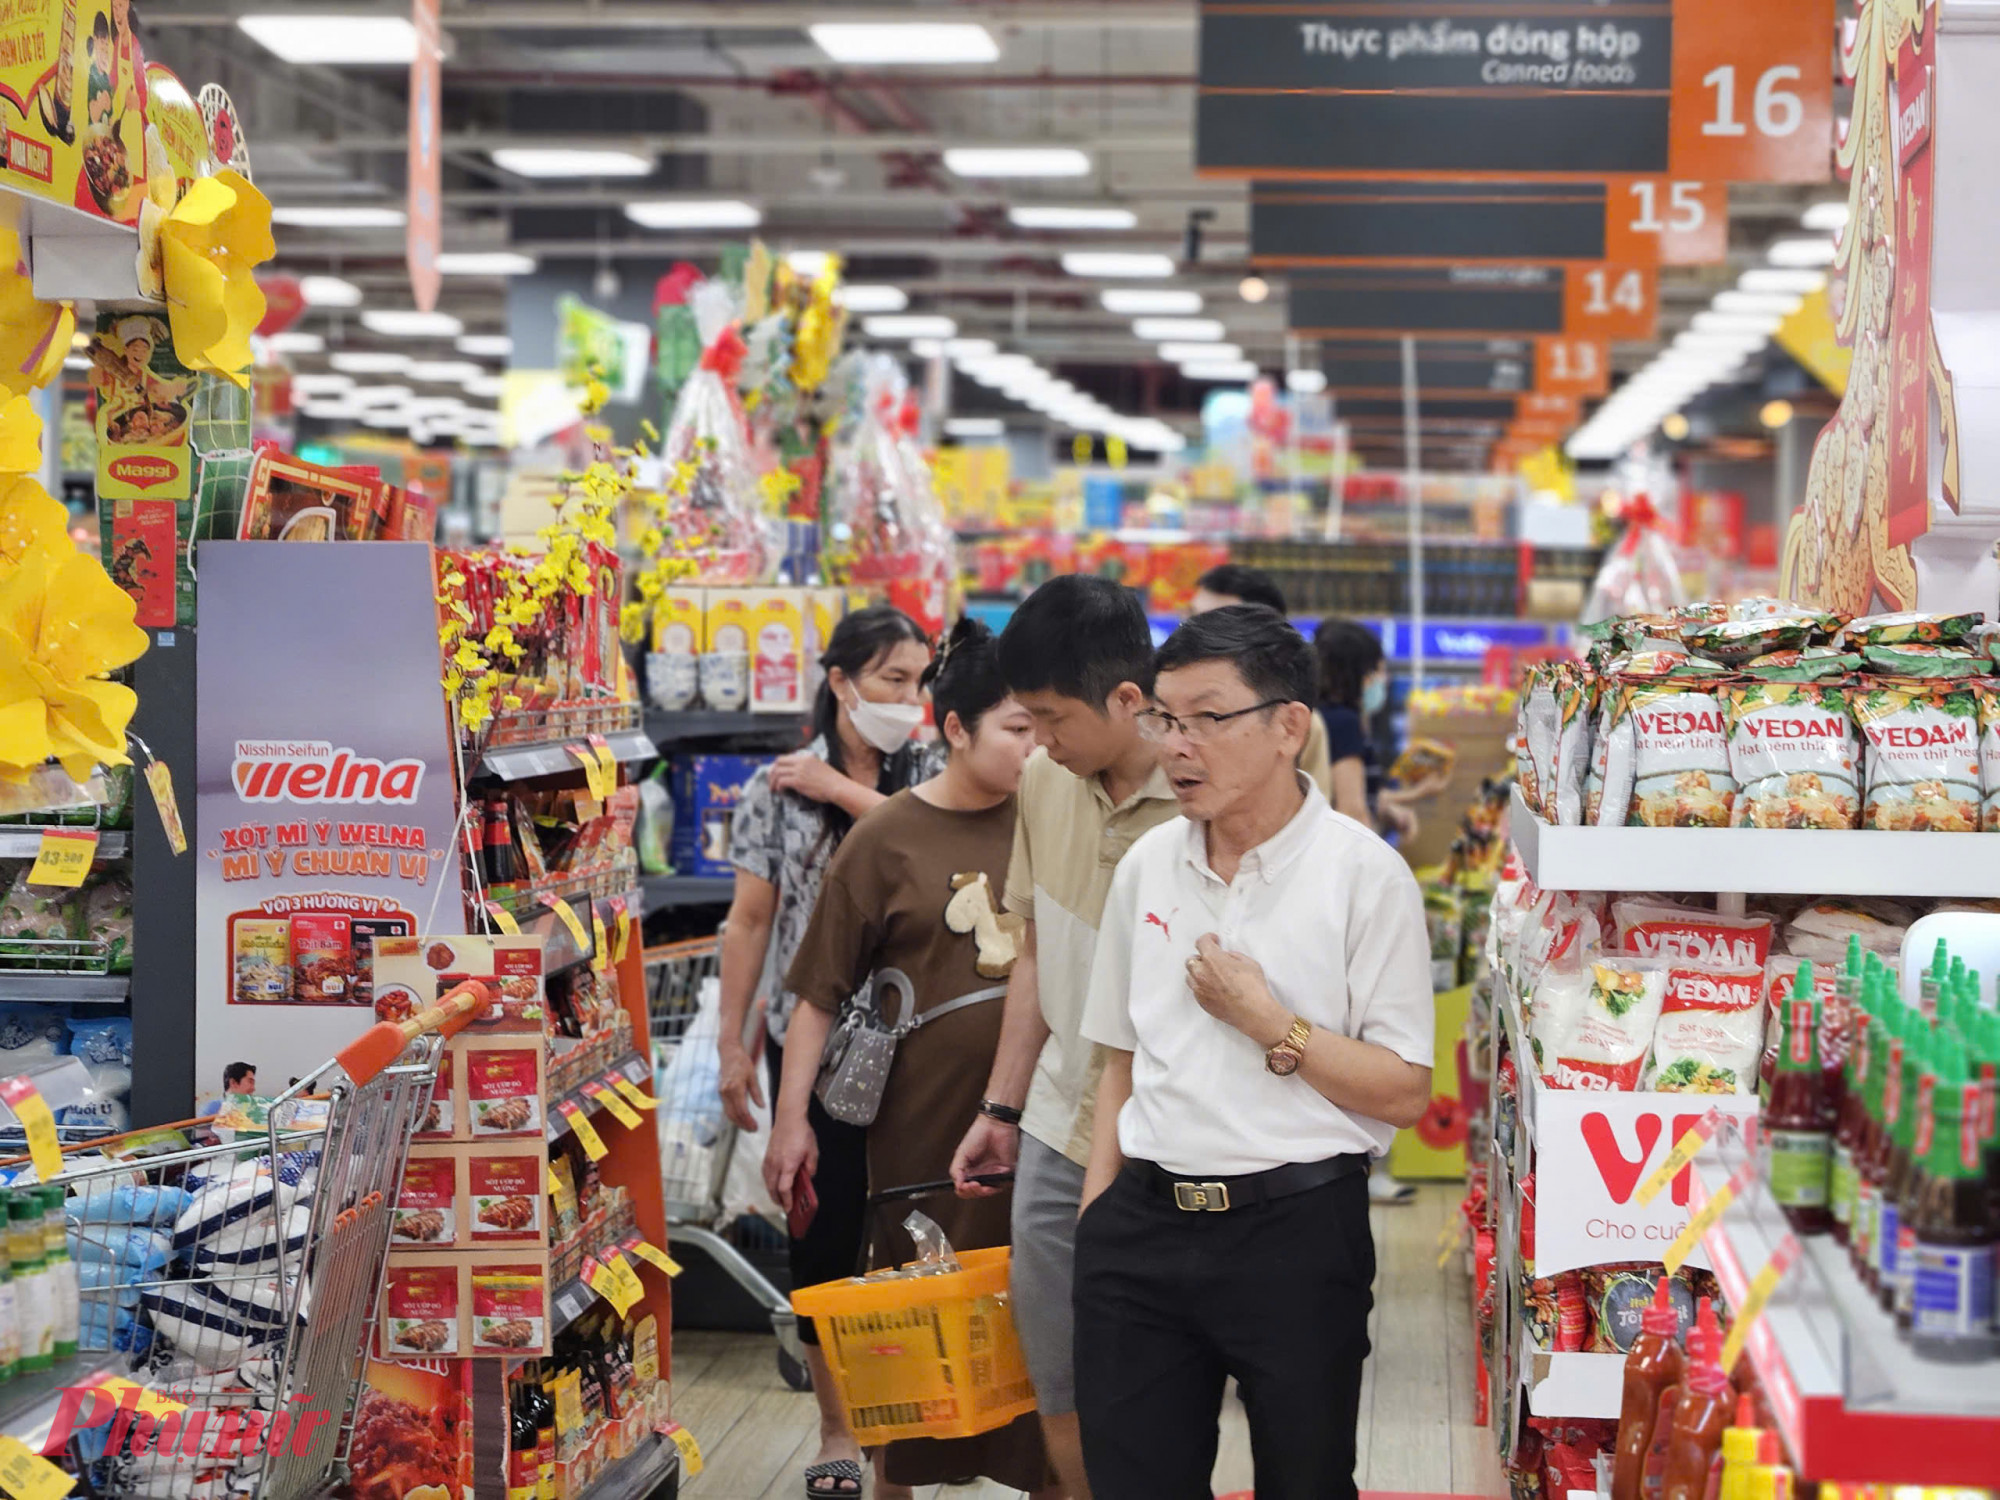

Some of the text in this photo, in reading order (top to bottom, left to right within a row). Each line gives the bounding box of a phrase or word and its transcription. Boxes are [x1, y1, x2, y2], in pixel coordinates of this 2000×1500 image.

[1299, 22, 1383, 60] Thực
[1576, 21, 1642, 59] hộp
[1481, 58, 1637, 87] Canned foods
[1701, 64, 1804, 138] 16
[1629, 180, 1706, 233] 15
[1582, 268, 1644, 316] 14
[1549, 342, 1599, 380] 13
[115, 462, 171, 479] Maggi
[1743, 717, 1844, 739] VEDAN
[1865, 721, 1968, 748] VEDAN
[238, 742, 329, 758] Nisshin Seifun
[275, 817, 309, 847] MÌ
[313, 816, 331, 846] Ý
[338, 821, 426, 849] WELNA
[293, 842, 391, 878] CHUẨN
[1633, 930, 1757, 968] VEDAN
[1664, 976, 1752, 1006] VEDAN
[1585, 1218, 1637, 1239] Cho
